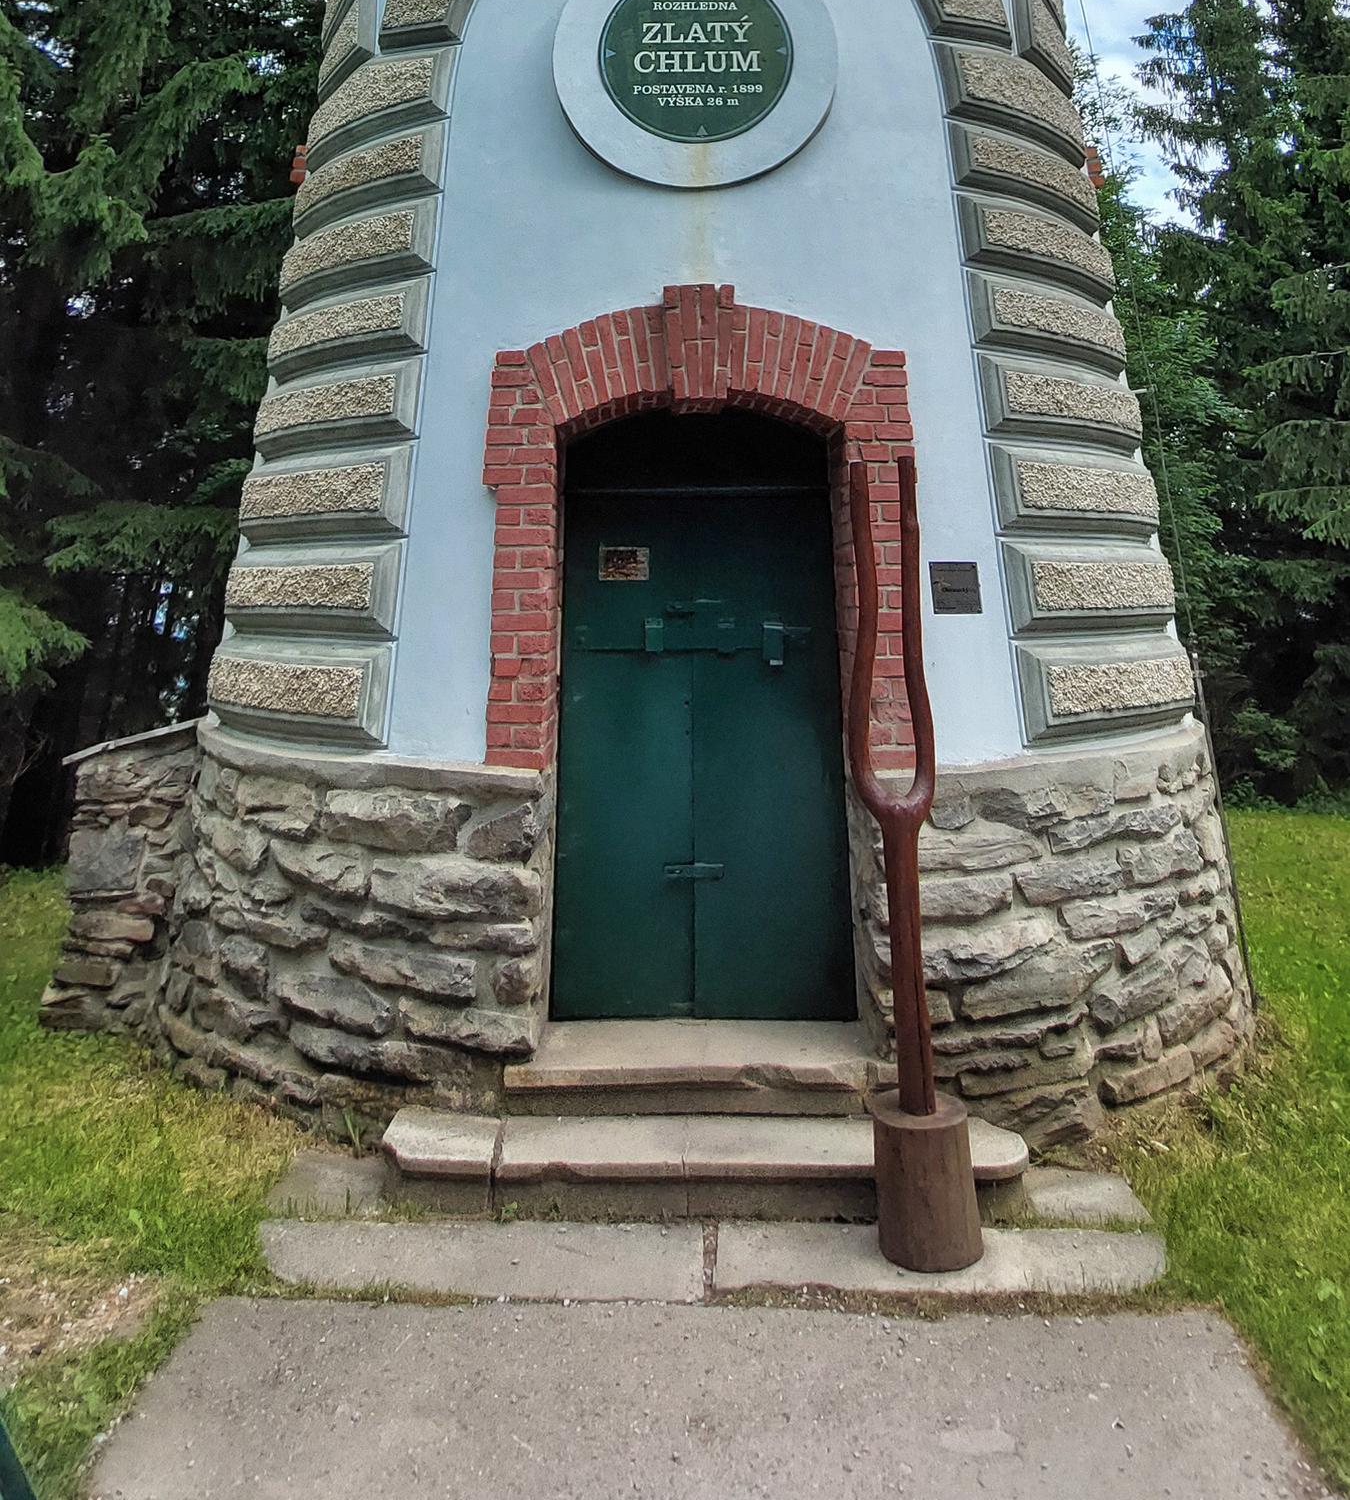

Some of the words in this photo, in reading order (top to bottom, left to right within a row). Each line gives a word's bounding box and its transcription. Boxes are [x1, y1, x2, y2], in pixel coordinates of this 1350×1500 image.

[653, 1, 737, 11] ROZHLEDNA
[642, 15, 753, 43] ZLATÝ
[634, 51, 761, 73] CHLUM
[633, 85, 715, 94] POSTAVENA
[732, 84, 763, 93] 1899
[658, 95, 704, 106] VÝŠKA
[707, 97, 722, 106] 26
